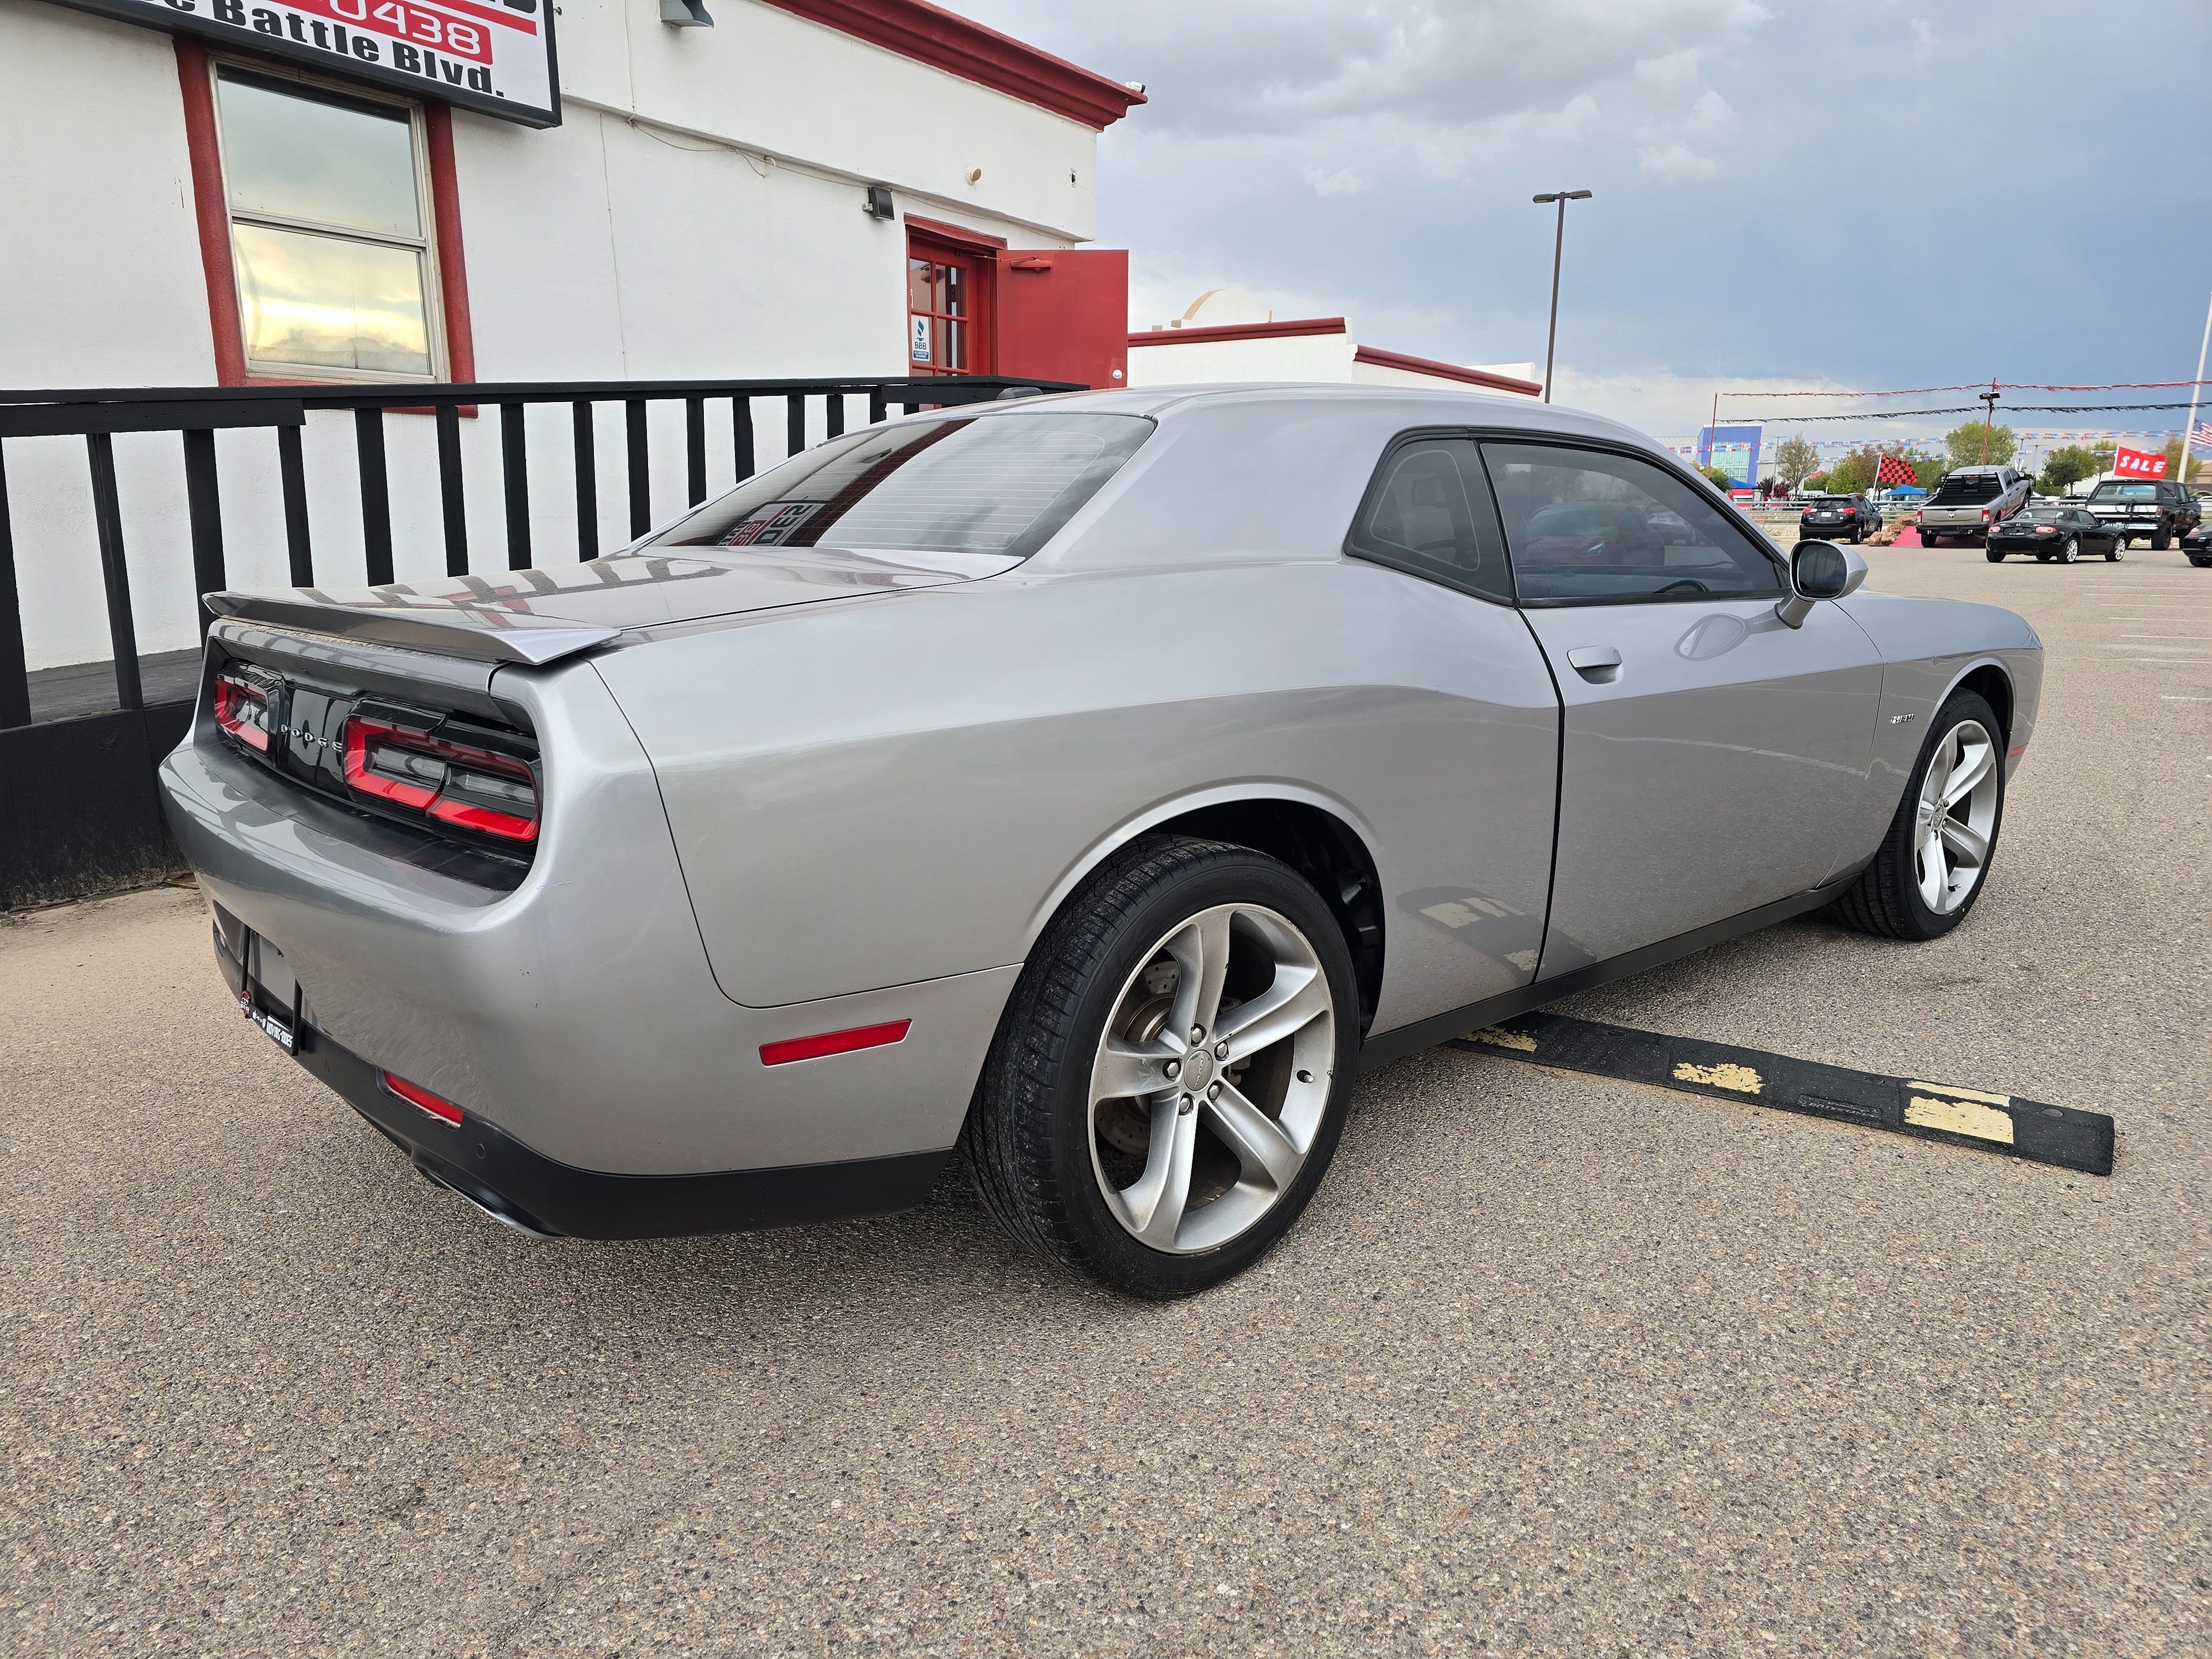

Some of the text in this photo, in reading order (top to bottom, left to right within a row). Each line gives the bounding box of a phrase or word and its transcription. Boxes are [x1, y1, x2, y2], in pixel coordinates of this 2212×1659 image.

[212, 0, 504, 98] Battle Blvd.
[915, 342, 927, 350] BBB
[2119, 455, 2166, 473] SALE
[281, 724, 342, 752] DODGE
